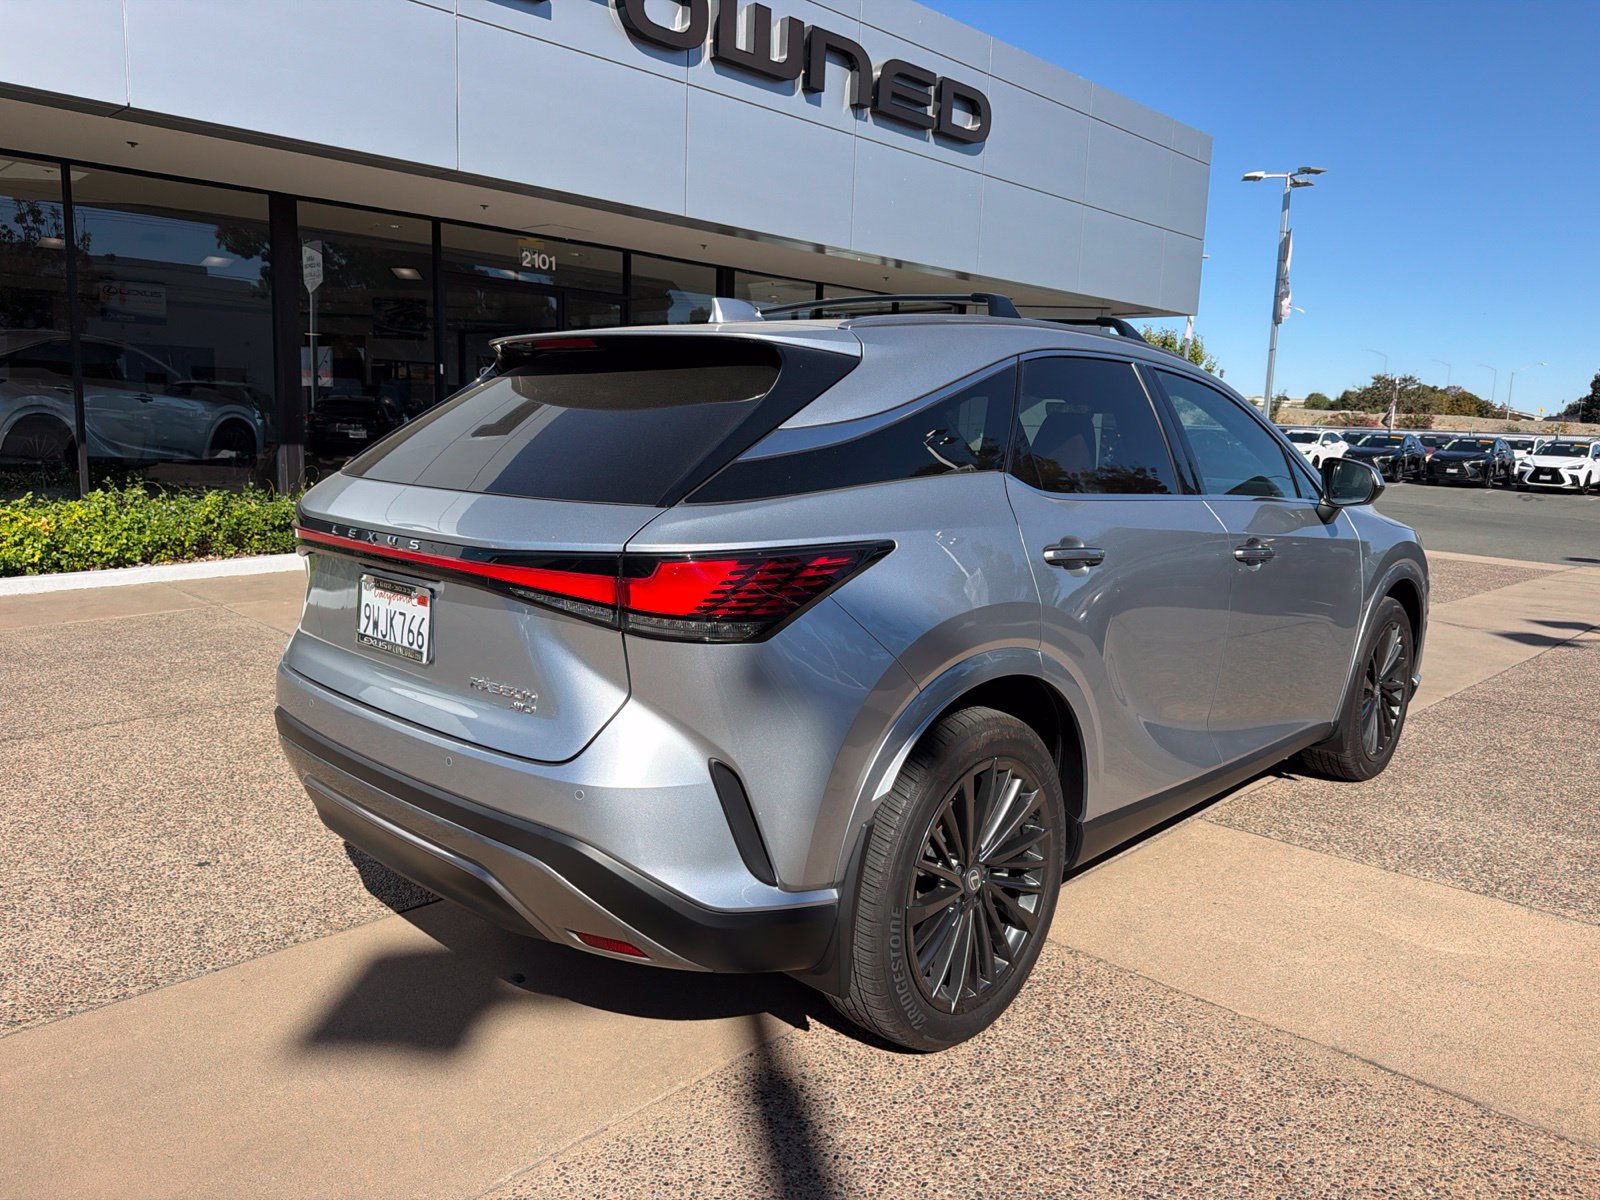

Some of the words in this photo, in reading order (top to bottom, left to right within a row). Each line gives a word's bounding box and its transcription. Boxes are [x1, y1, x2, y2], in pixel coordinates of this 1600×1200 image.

[521, 251, 556, 271] 2101
[332, 526, 420, 549] LEXUS
[363, 602, 426, 650] 9WJK766
[889, 905, 929, 1031] BRIDGESTONE
